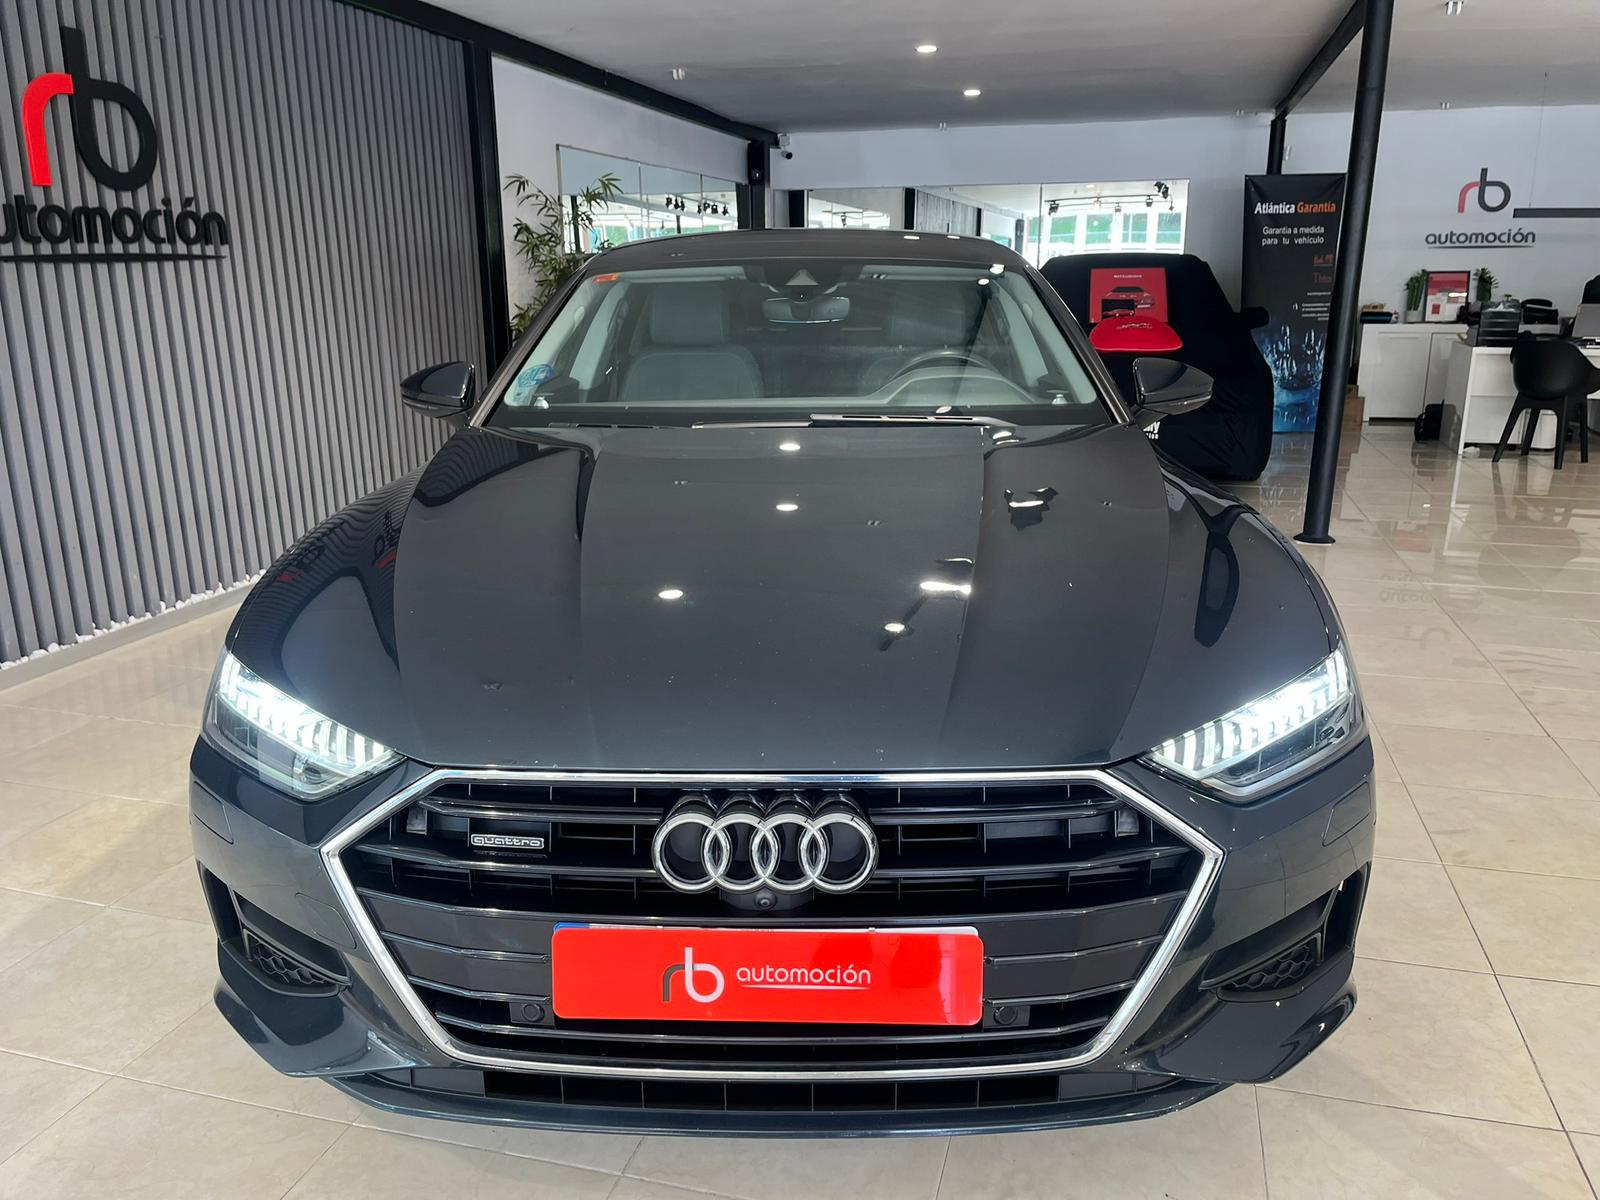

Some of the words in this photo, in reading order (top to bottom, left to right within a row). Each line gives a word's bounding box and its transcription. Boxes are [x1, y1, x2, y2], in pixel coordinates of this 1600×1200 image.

[1254, 202, 1295, 214] Atlántica
[1297, 201, 1336, 213] Garantía
[1299, 225, 1325, 234] medida
[1262, 237, 1279, 246] para
[1282, 237, 1290, 245] tu
[1425, 227, 1536, 245] automoción
[473, 836, 541, 847] quattro
[736, 964, 871, 984] automoción
